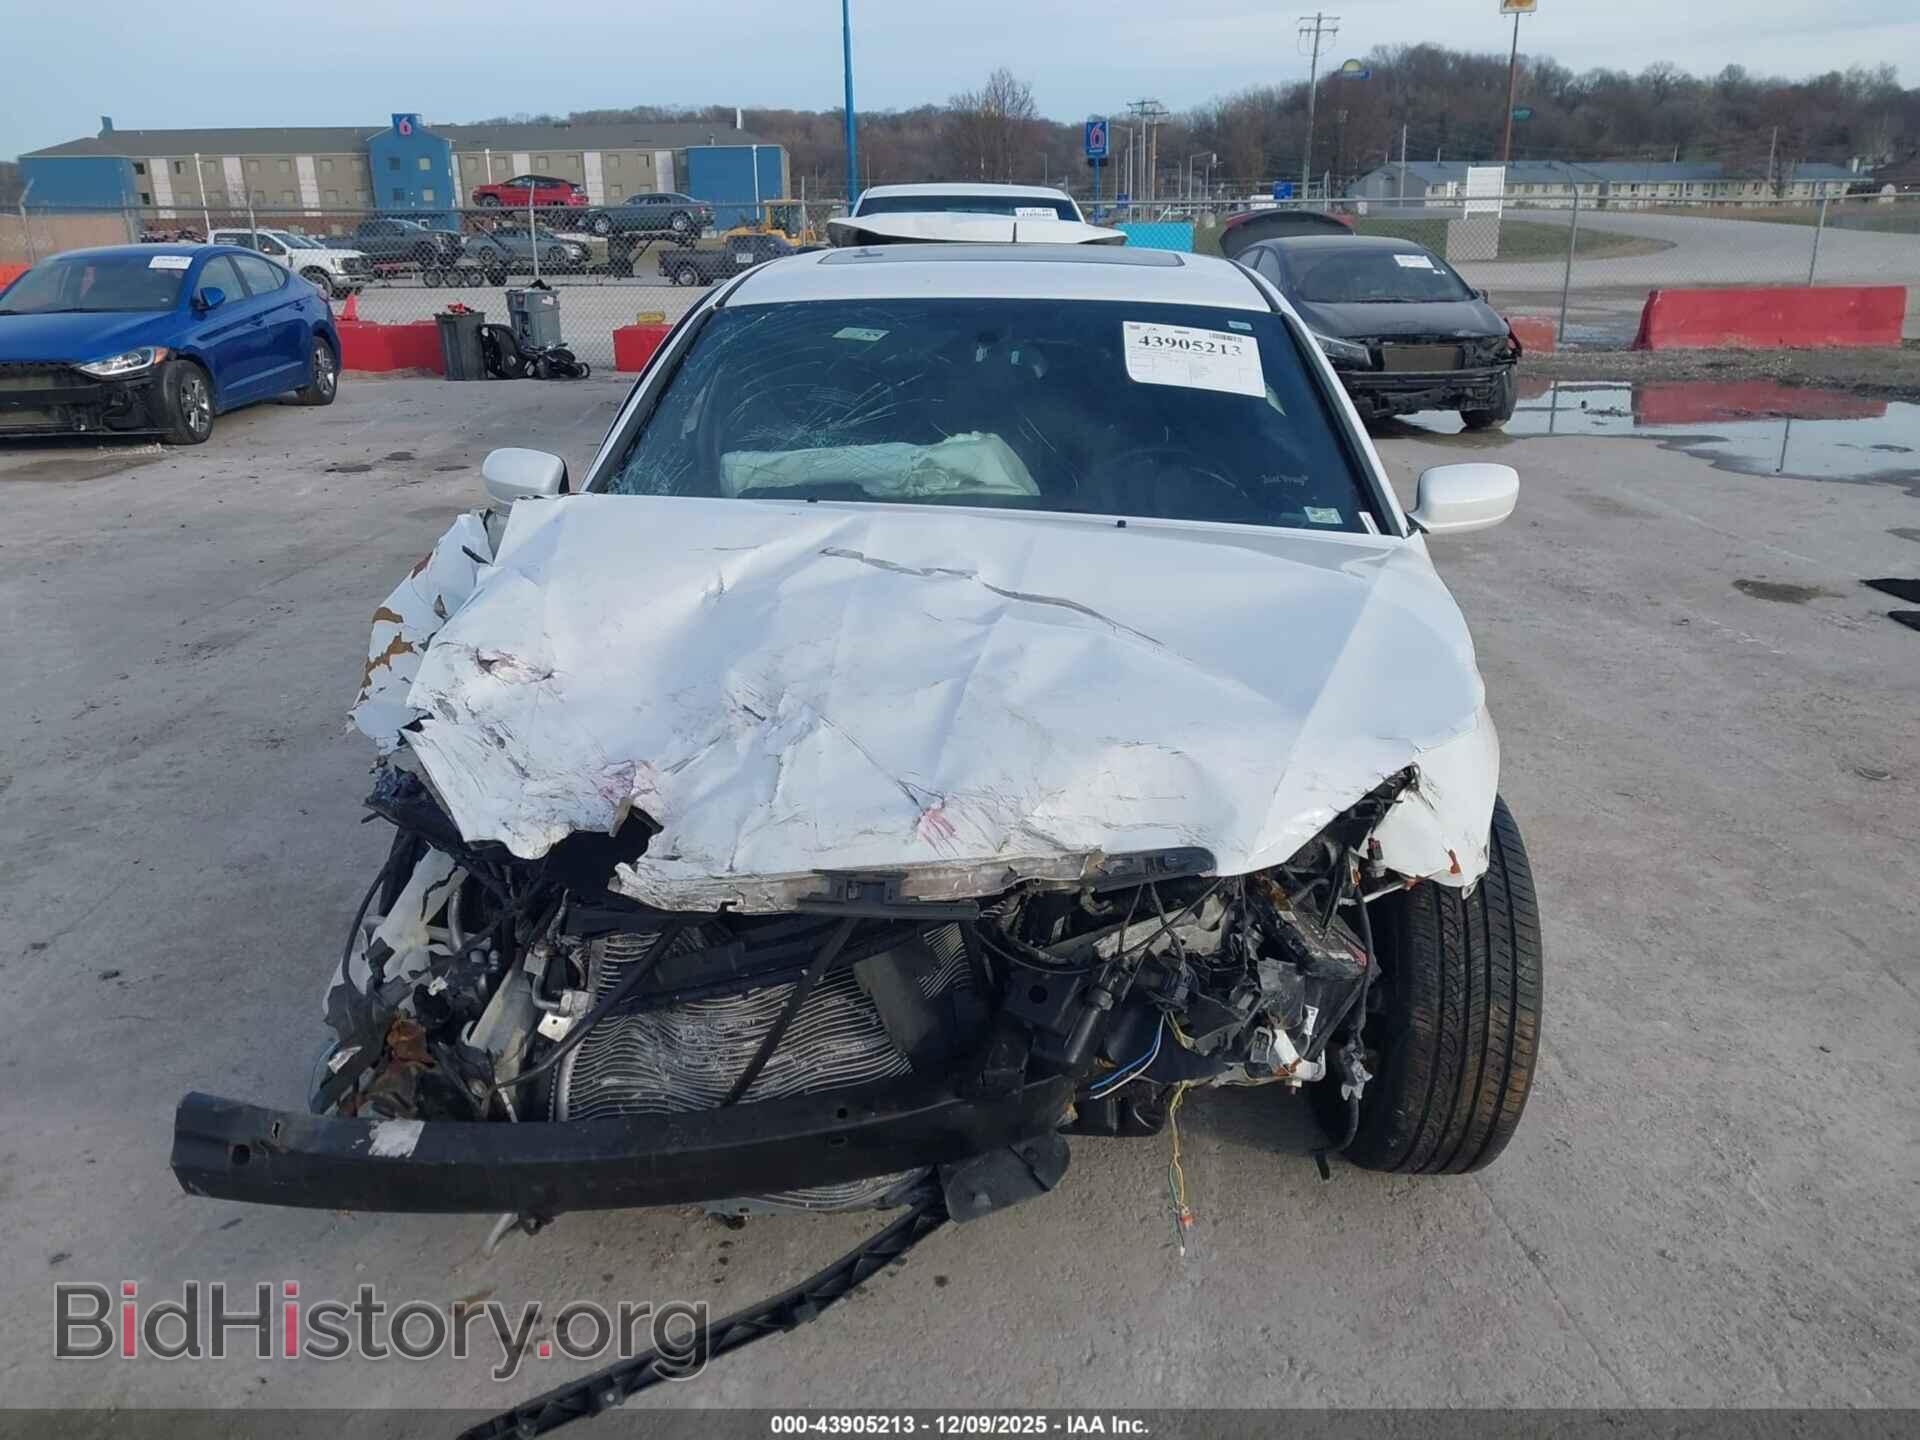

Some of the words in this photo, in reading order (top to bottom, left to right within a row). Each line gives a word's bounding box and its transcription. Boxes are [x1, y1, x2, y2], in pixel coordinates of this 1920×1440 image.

[400, 116, 412, 136] 6
[1090, 122, 1105, 148] 6
[1138, 334, 1242, 356] 43905213
